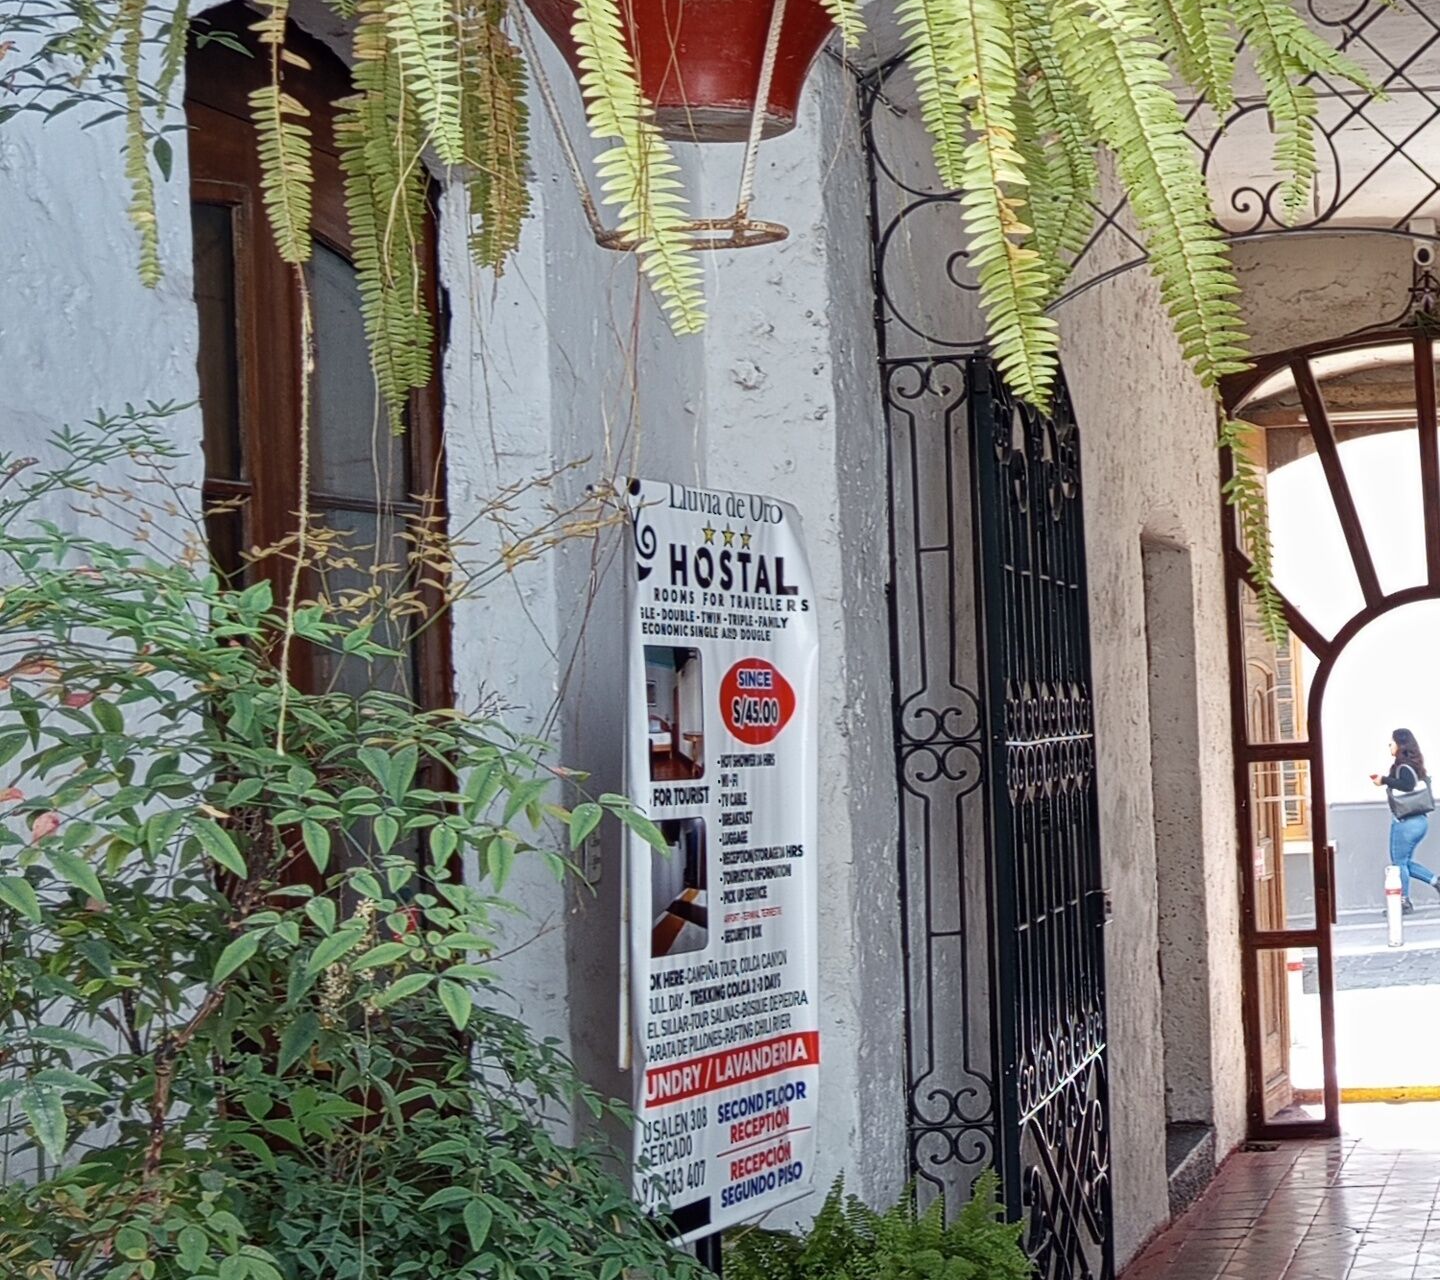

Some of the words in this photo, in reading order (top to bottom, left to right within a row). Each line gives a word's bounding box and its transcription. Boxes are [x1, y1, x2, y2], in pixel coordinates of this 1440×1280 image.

[669, 482, 722, 517] Lluvia
[725, 492, 745, 519] de
[750, 494, 783, 524] Oro
[669, 543, 799, 596] HOSTAL
[654, 587, 695, 605] ROOMS
[703, 591, 725, 607] FOR
[730, 594, 809, 612] TRAVELLERS
[642, 623, 688, 636] ECONOMIC
[690, 626, 718, 638] SINGLE
[661, 608, 694, 622] DOUBLE
[728, 613, 753, 627] TRIPLE
[738, 670, 772, 687] SINCE
[732, 695, 779, 728] S/45.00
[653, 788, 671, 807] FOR
[674, 786, 709, 806] TOURIST
[669, 993, 684, 1011] DAY
[727, 979, 751, 999] COLCA
[647, 1041, 677, 1062] ARATA
[715, 1038, 808, 1083] LAVANDERIA
[717, 1094, 764, 1124] SECOND
[766, 1081, 806, 1109] FLOOR
[642, 1111, 689, 1144] USALEN
[690, 1106, 708, 1131] 308
[687, 1160, 706, 1189] 407
[730, 1139, 791, 1181] RECEPCIÓN
[721, 1172, 775, 1208] SEGUNDO
[777, 1161, 803, 1188] PISO
